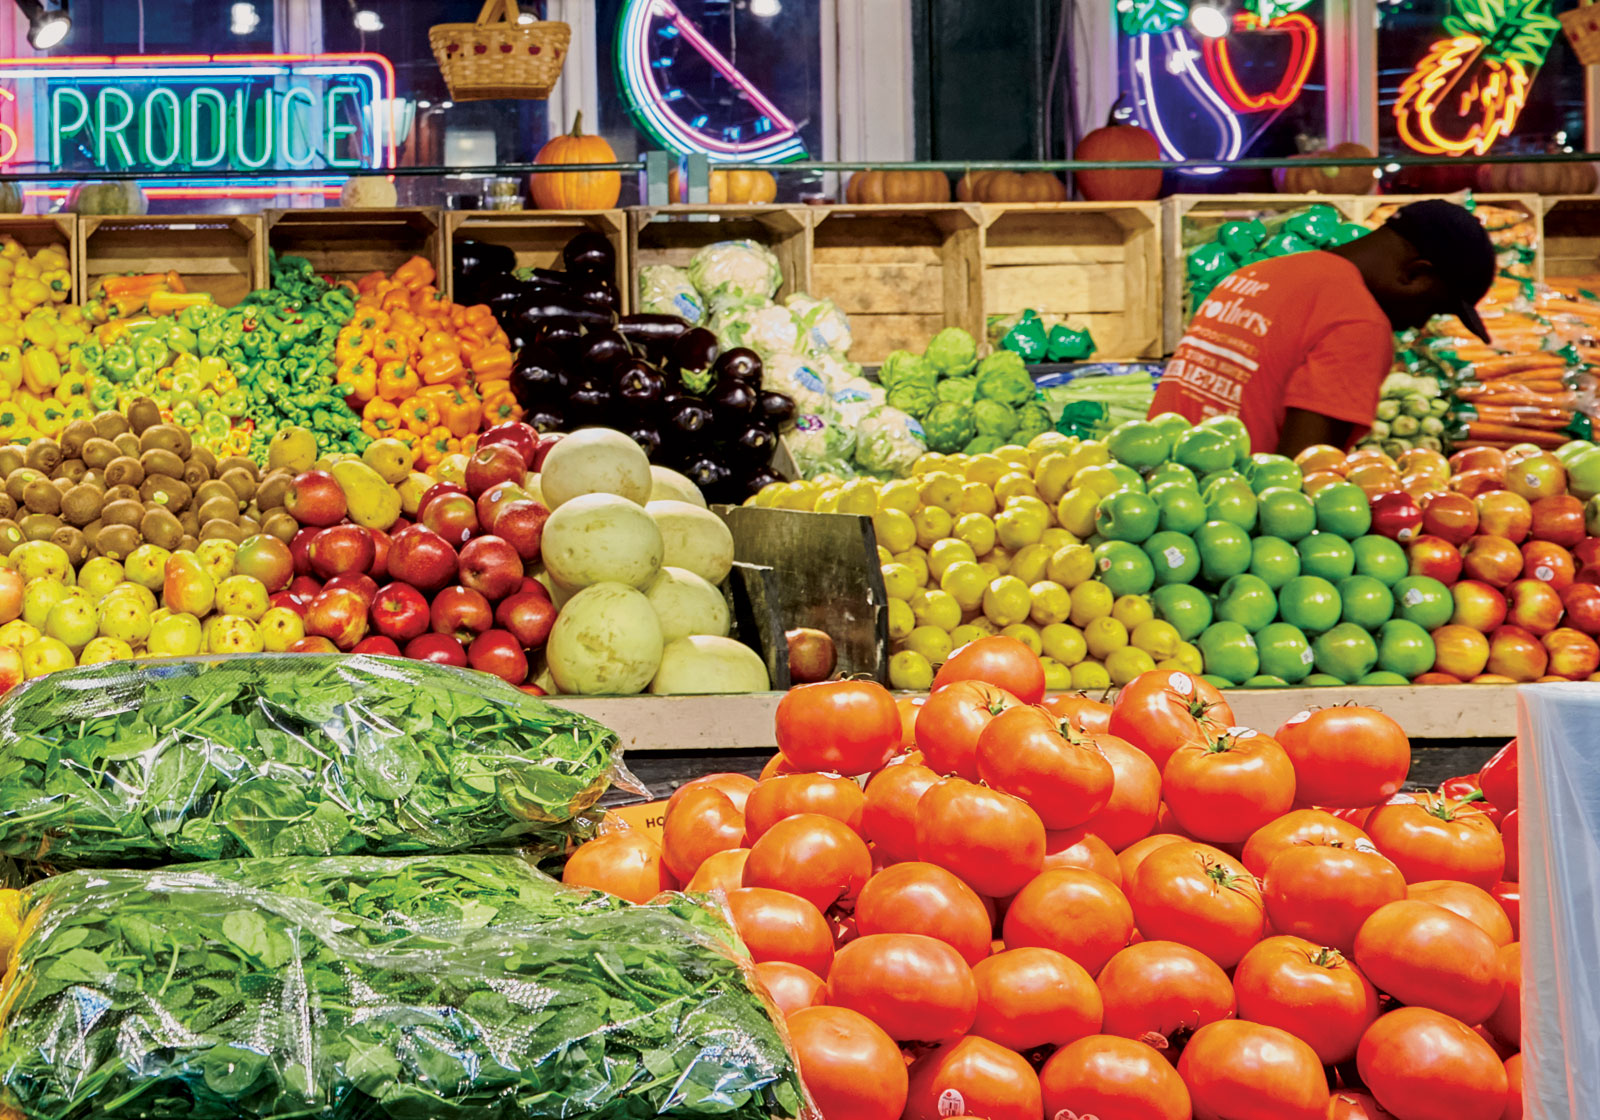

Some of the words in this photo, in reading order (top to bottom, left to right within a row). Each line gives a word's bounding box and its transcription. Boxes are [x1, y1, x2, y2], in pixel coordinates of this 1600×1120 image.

[52, 87, 362, 168] PRODUCE
[1216, 270, 1270, 297] vine
[1195, 297, 1272, 337] rothers
